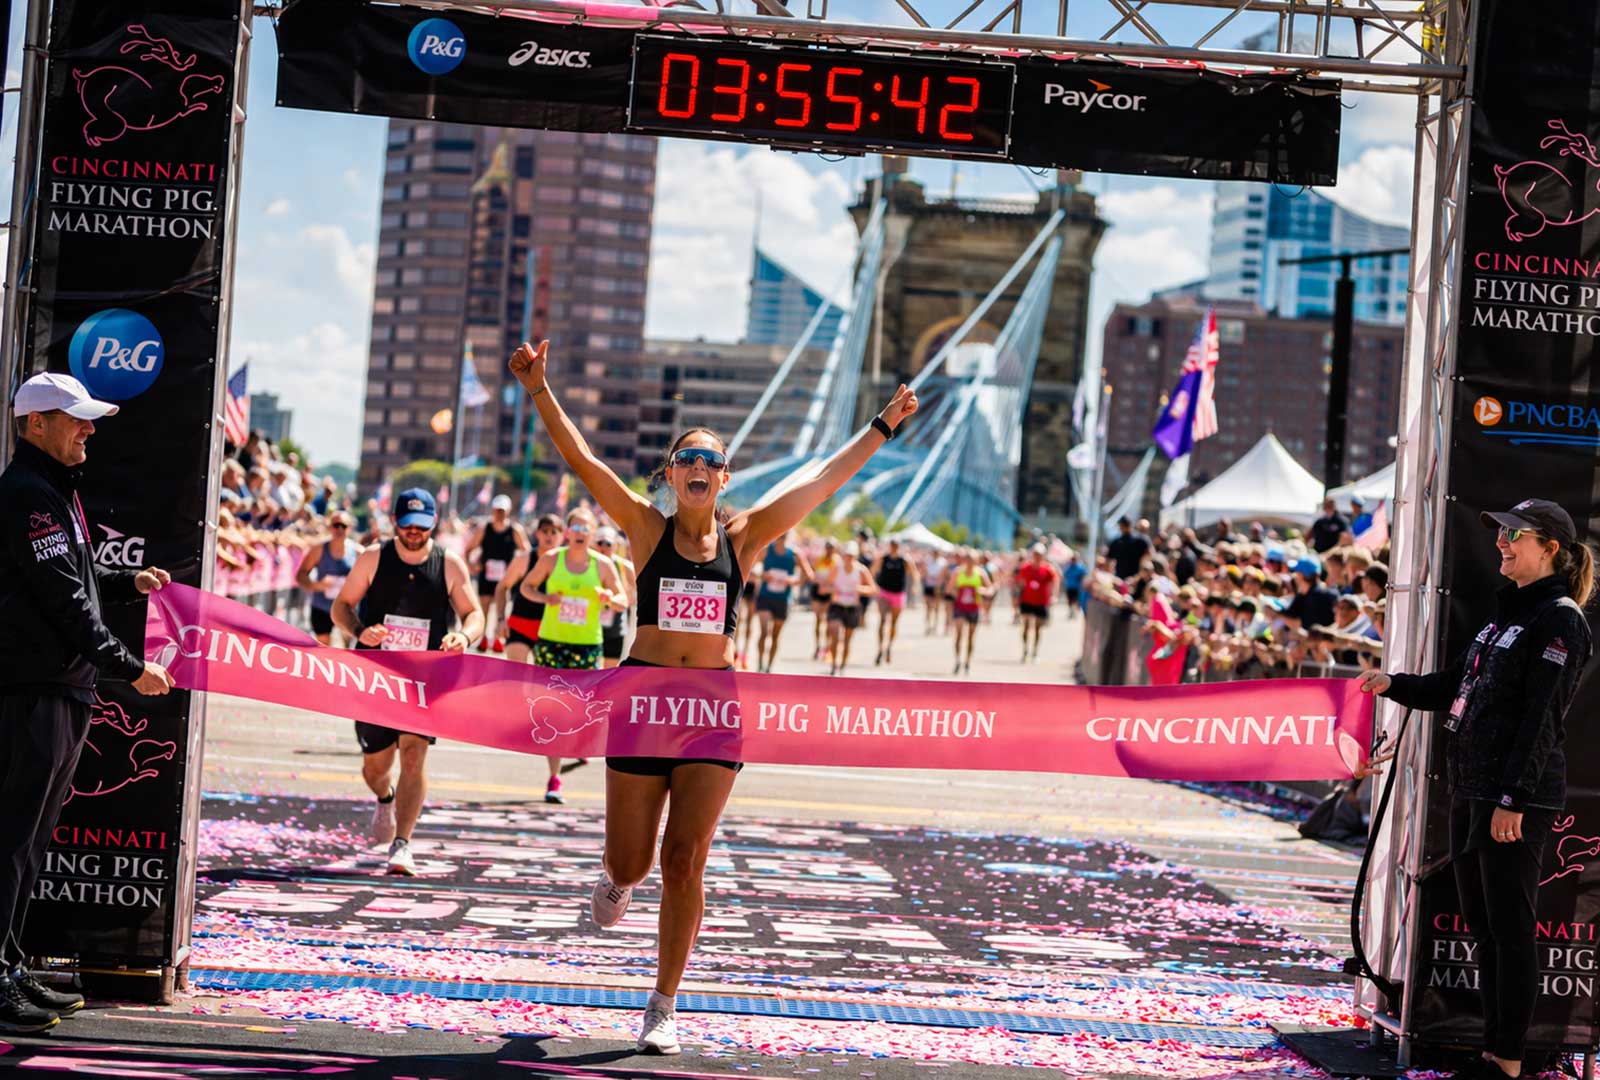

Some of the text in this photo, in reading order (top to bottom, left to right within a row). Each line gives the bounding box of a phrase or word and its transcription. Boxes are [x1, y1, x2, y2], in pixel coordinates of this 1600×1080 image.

[420, 35, 464, 58] P&G
[658, 52, 980, 140] 03:55:42
[1044, 83, 1147, 113] Paycor
[52, 156, 215, 182] CINCINNATI
[50, 182, 214, 211] FLYING PIG
[48, 210, 214, 240] MARATHON
[1473, 278, 1570, 305] FLYING
[1471, 306, 1600, 336] MARATHO
[89, 337, 160, 372] P&G
[1507, 401, 1600, 429] PNCBA
[32, 532, 66, 552] FLYING
[666, 596, 719, 621] 3283
[385, 629, 422, 648] 5236
[178, 625, 428, 709] CINCINNATI
[629, 695, 997, 739] FLYING PIG MARATHON
[1086, 715, 1337, 746] CINCINNATI
[52, 826, 167, 849] CINNATI
[44, 851, 101, 876] ING
[30, 879, 164, 909] RATHON
[1432, 939, 1478, 962] FLY
